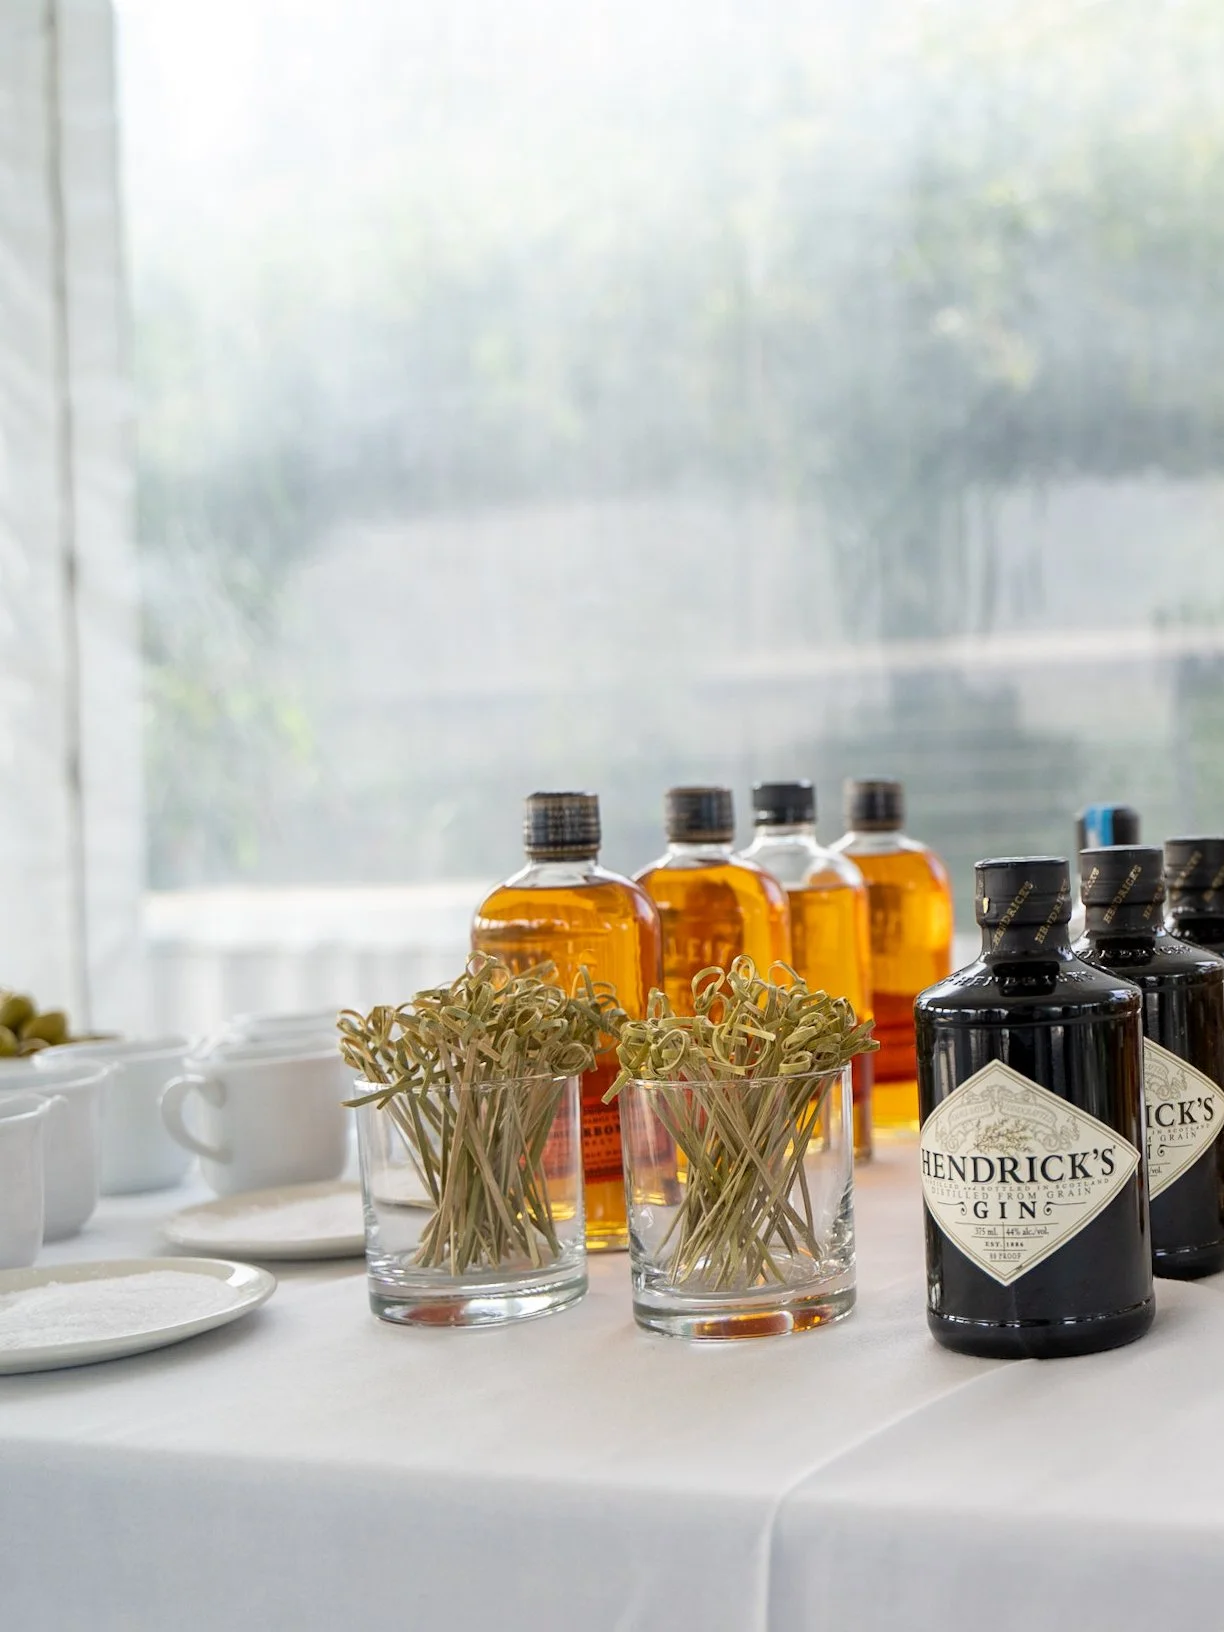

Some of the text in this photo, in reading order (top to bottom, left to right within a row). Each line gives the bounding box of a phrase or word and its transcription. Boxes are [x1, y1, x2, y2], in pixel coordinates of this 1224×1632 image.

[1159, 1131, 1197, 1142] GRAIN
[921, 1148, 1116, 1185] HENDRICK'S
[931, 1186, 1092, 1200] DISTILLED FROM GRAIN
[973, 1200, 1037, 1219] GIN
